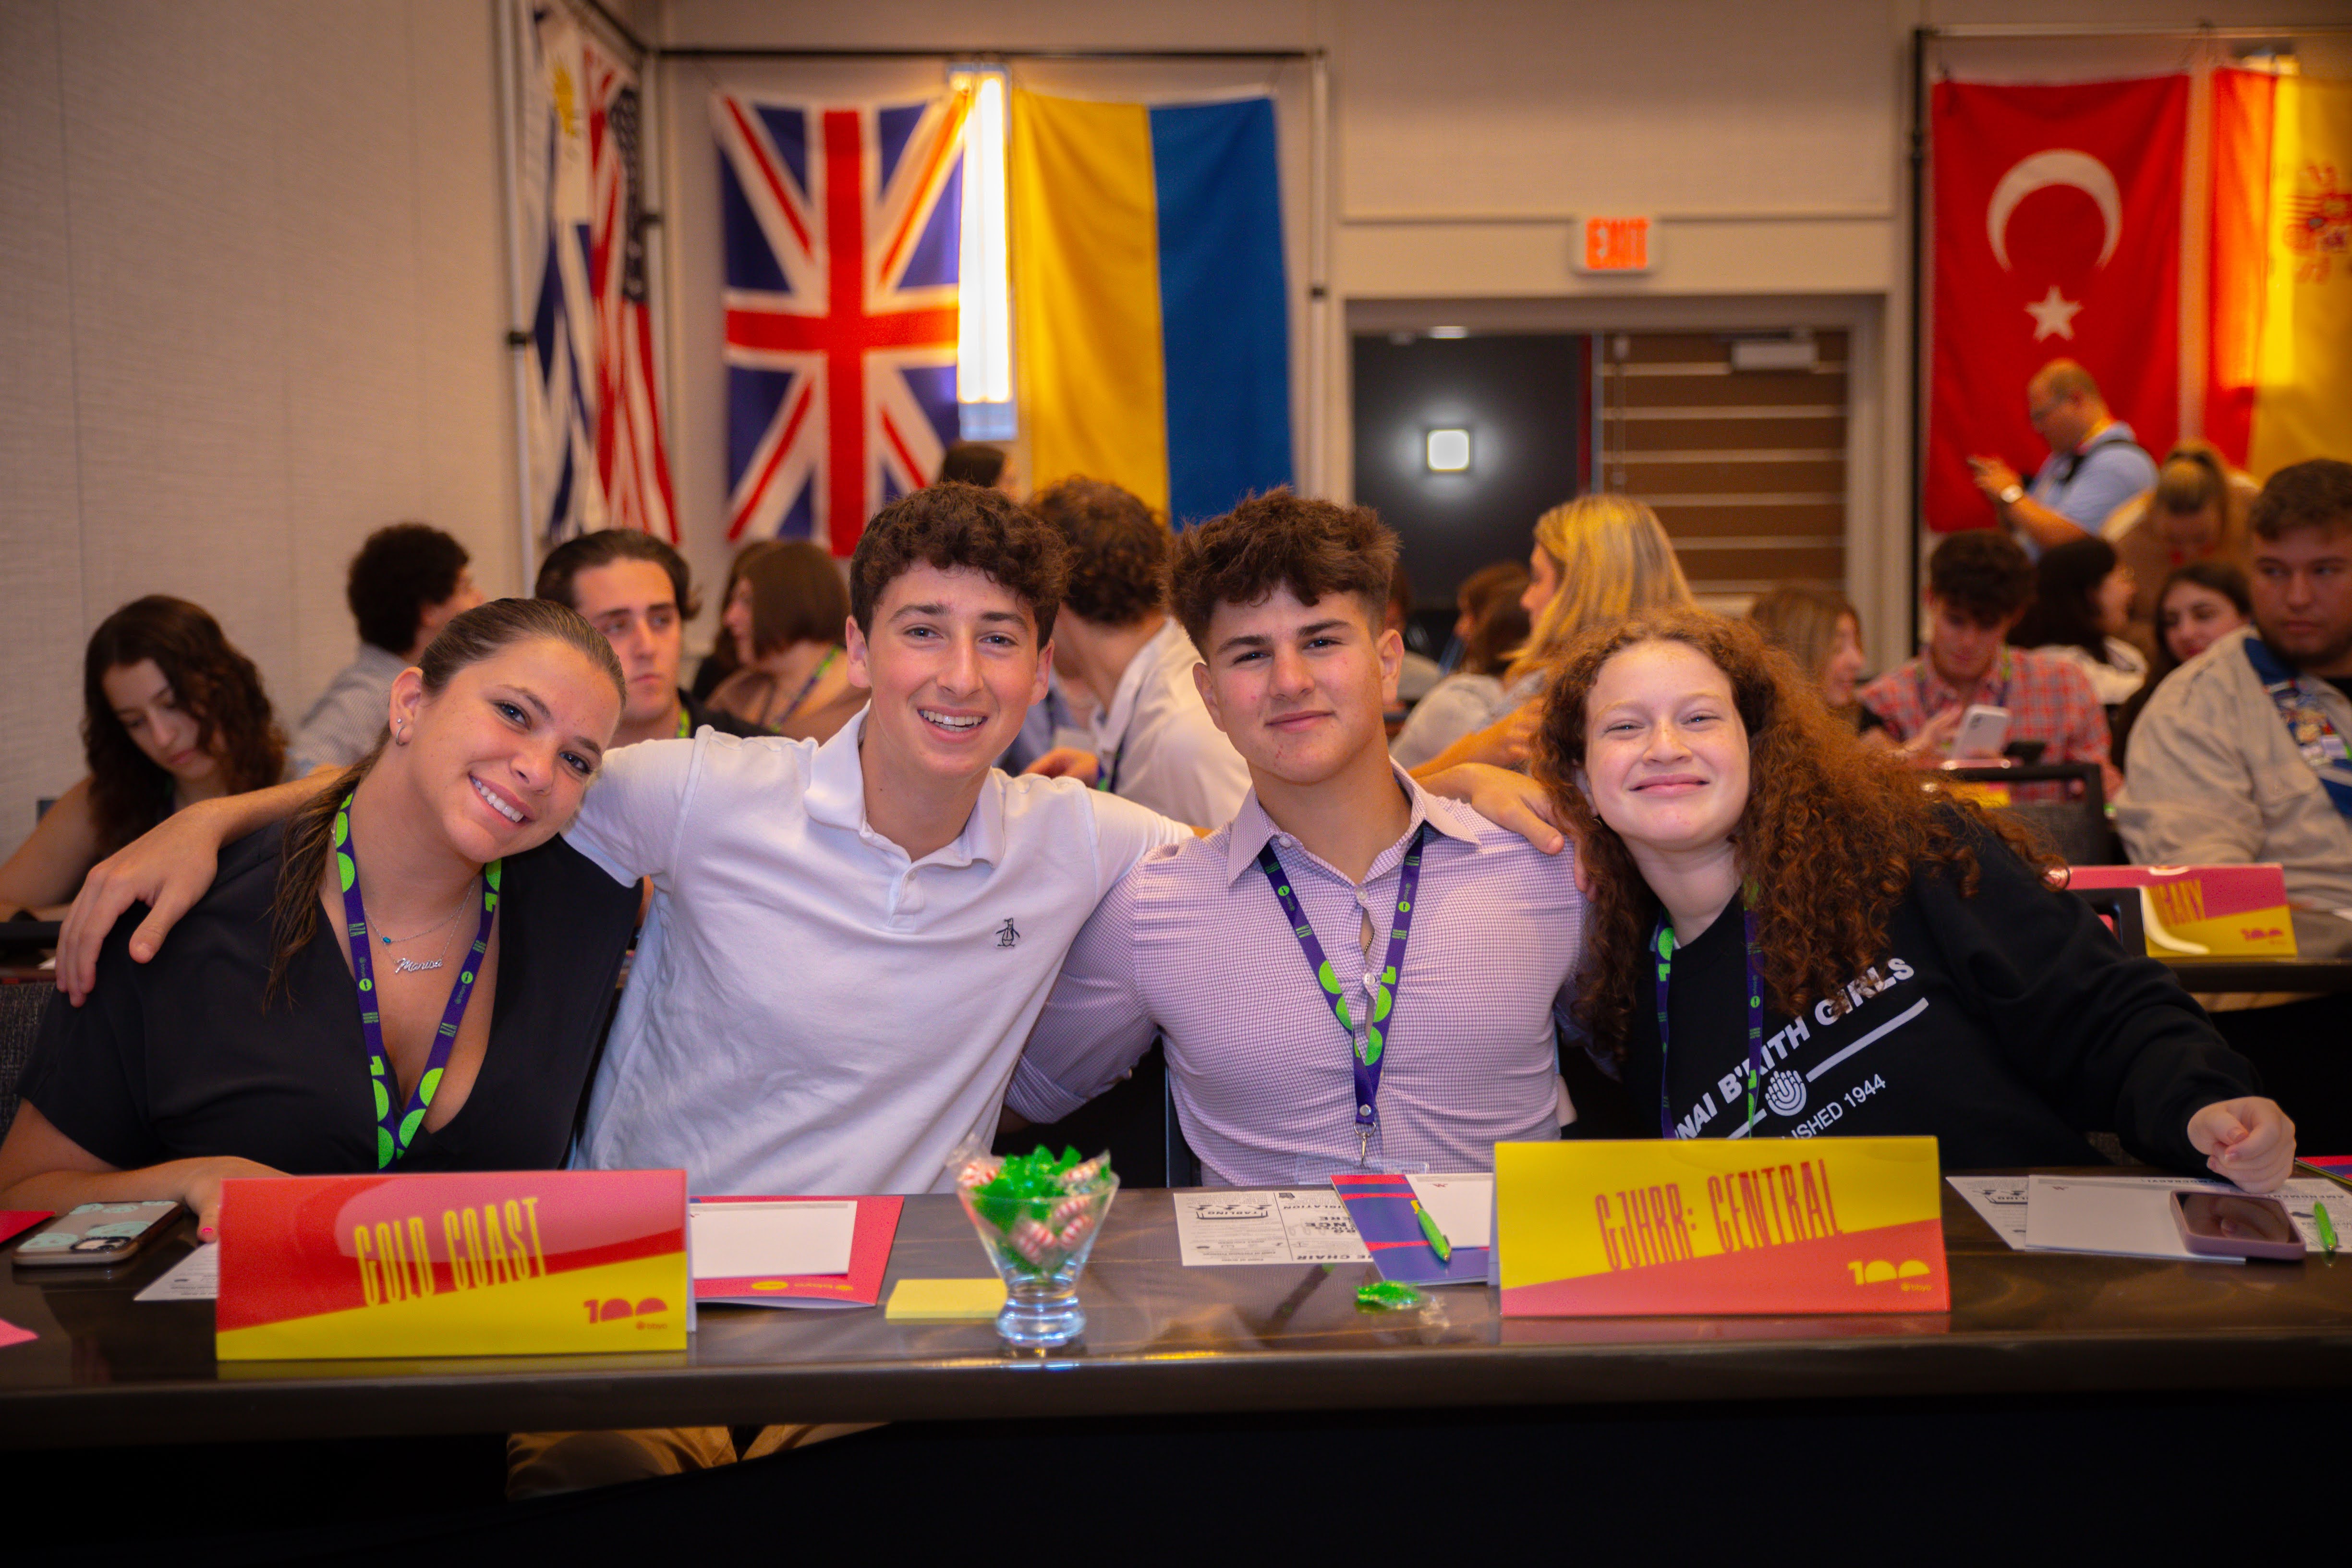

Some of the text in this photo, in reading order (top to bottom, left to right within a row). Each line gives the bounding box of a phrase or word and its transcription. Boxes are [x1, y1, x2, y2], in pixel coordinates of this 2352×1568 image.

[1586, 217, 1650, 270] EXIT
[1675, 1092, 1718, 1139] NAI
[1790, 1074, 1886, 1139] ISHED 1944
[1707, 1159, 1844, 1253] CENTRAL
[354, 1197, 546, 1307] GOLD COAST
